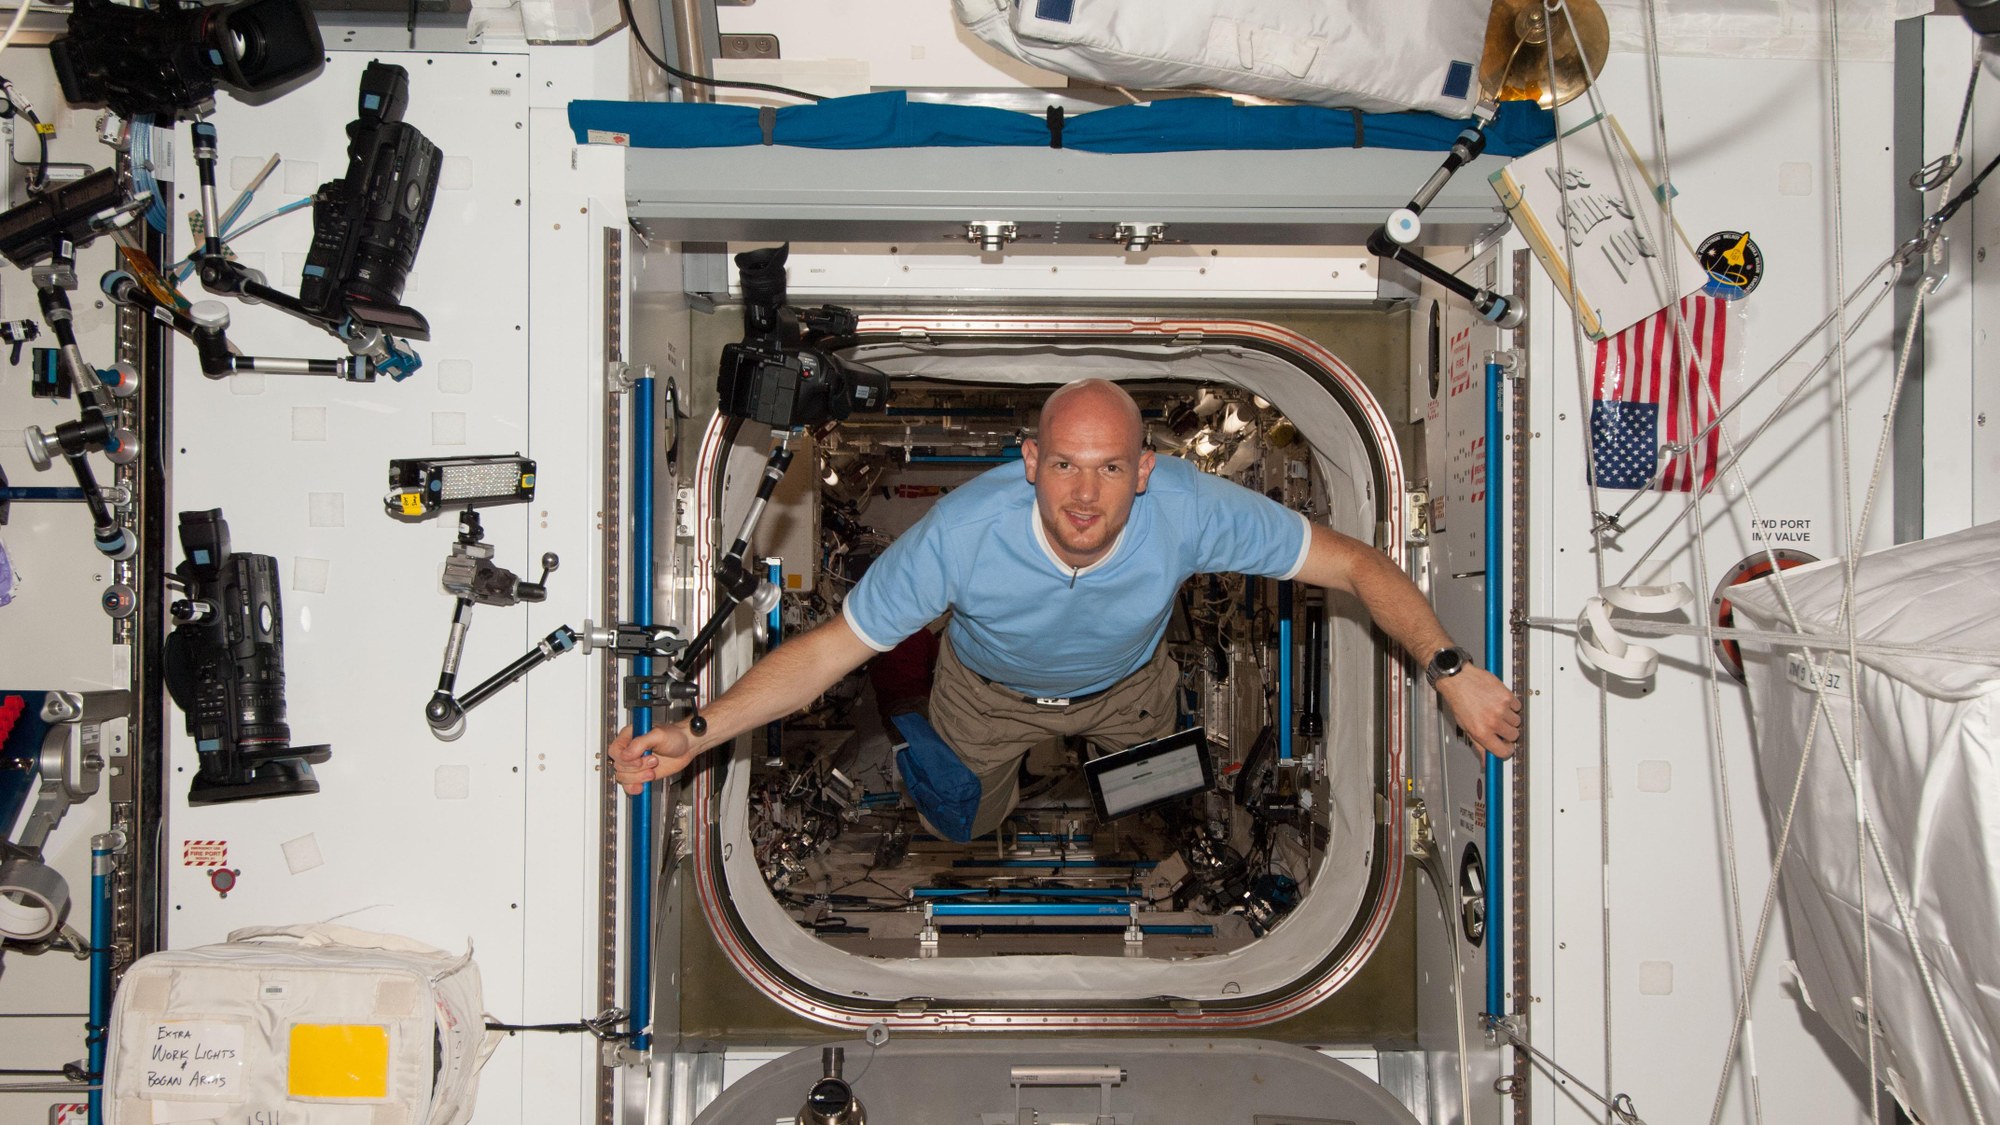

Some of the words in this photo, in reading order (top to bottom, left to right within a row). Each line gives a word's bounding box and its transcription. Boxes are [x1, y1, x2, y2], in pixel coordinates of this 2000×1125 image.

[1752, 520, 1777, 528] FWD
[1780, 520, 1811, 528] PORT
[1775, 533, 1810, 541] VALVE
[157, 1026, 191, 1040] EXTRA
[152, 1044, 189, 1062] WORK
[194, 1043, 235, 1060] LIGHTS
[147, 1071, 182, 1088] BOGAN
